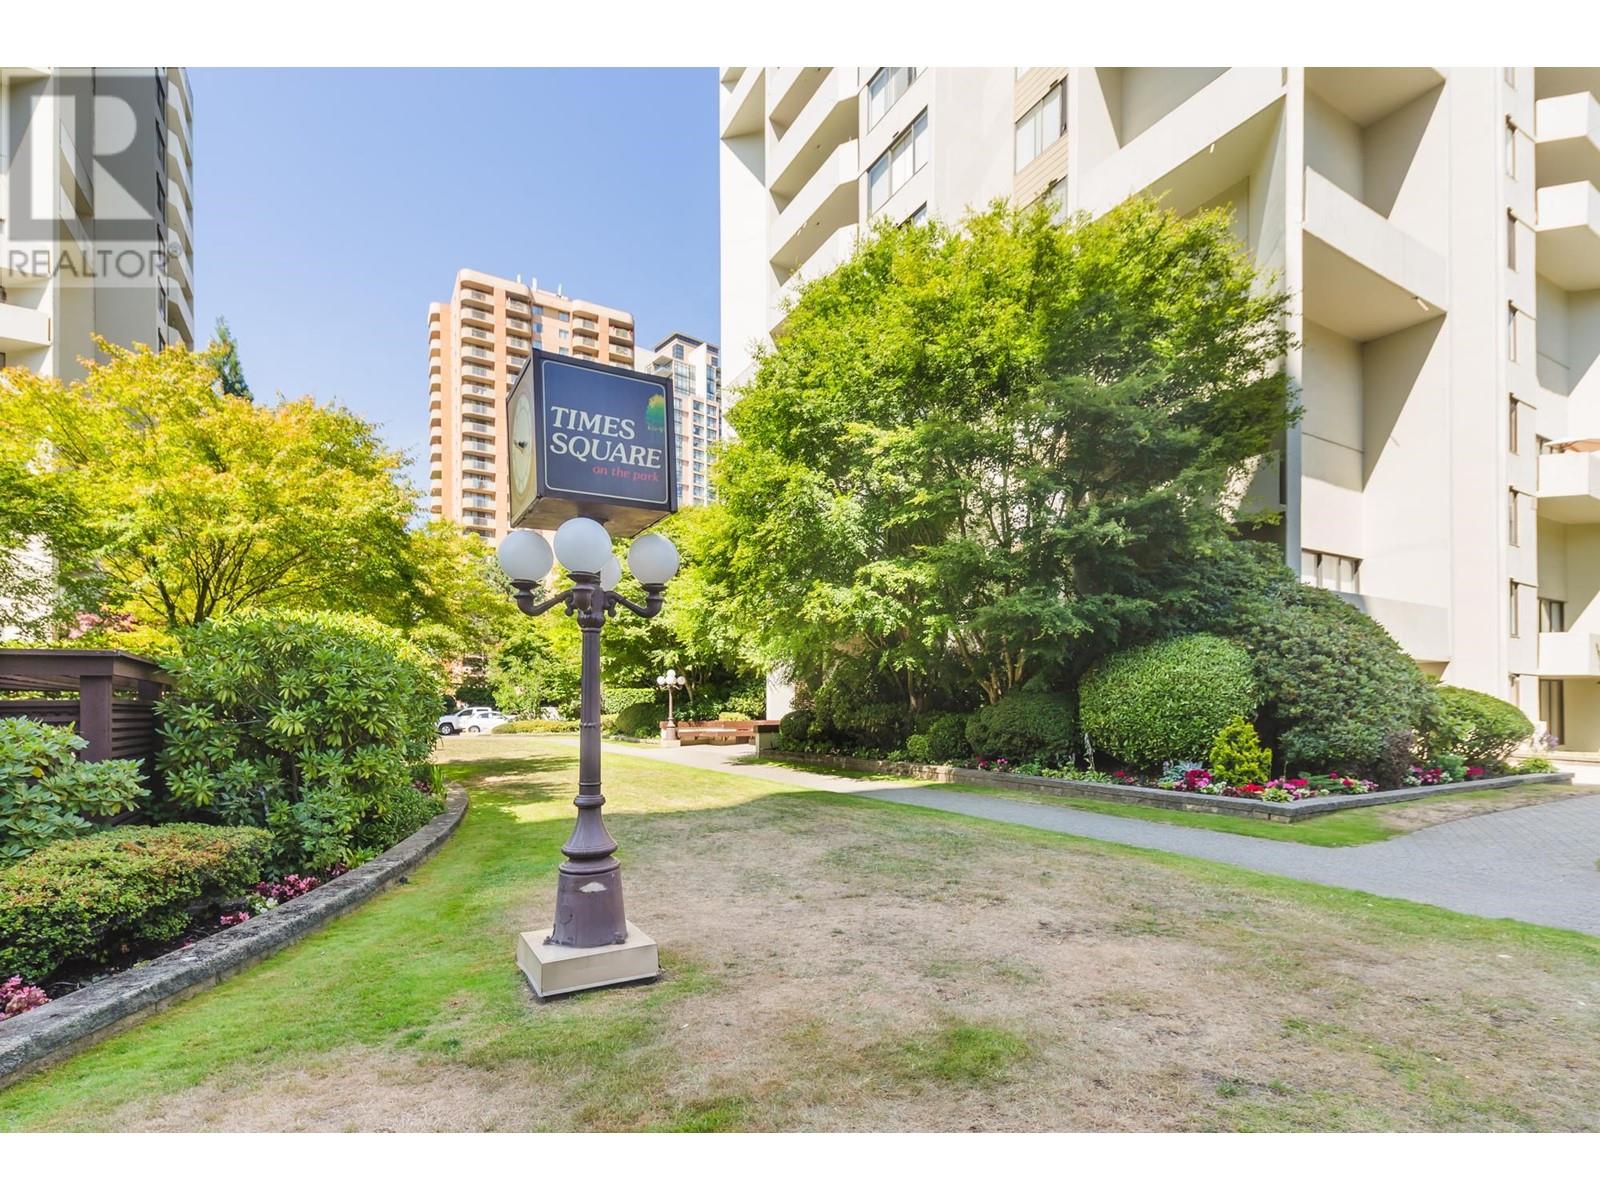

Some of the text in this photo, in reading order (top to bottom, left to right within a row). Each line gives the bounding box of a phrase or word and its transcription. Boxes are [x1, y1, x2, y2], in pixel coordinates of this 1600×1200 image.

[550, 406, 635, 440] TIMES
[550, 432, 662, 469] SQUARE
[592, 465, 659, 482] on the park
